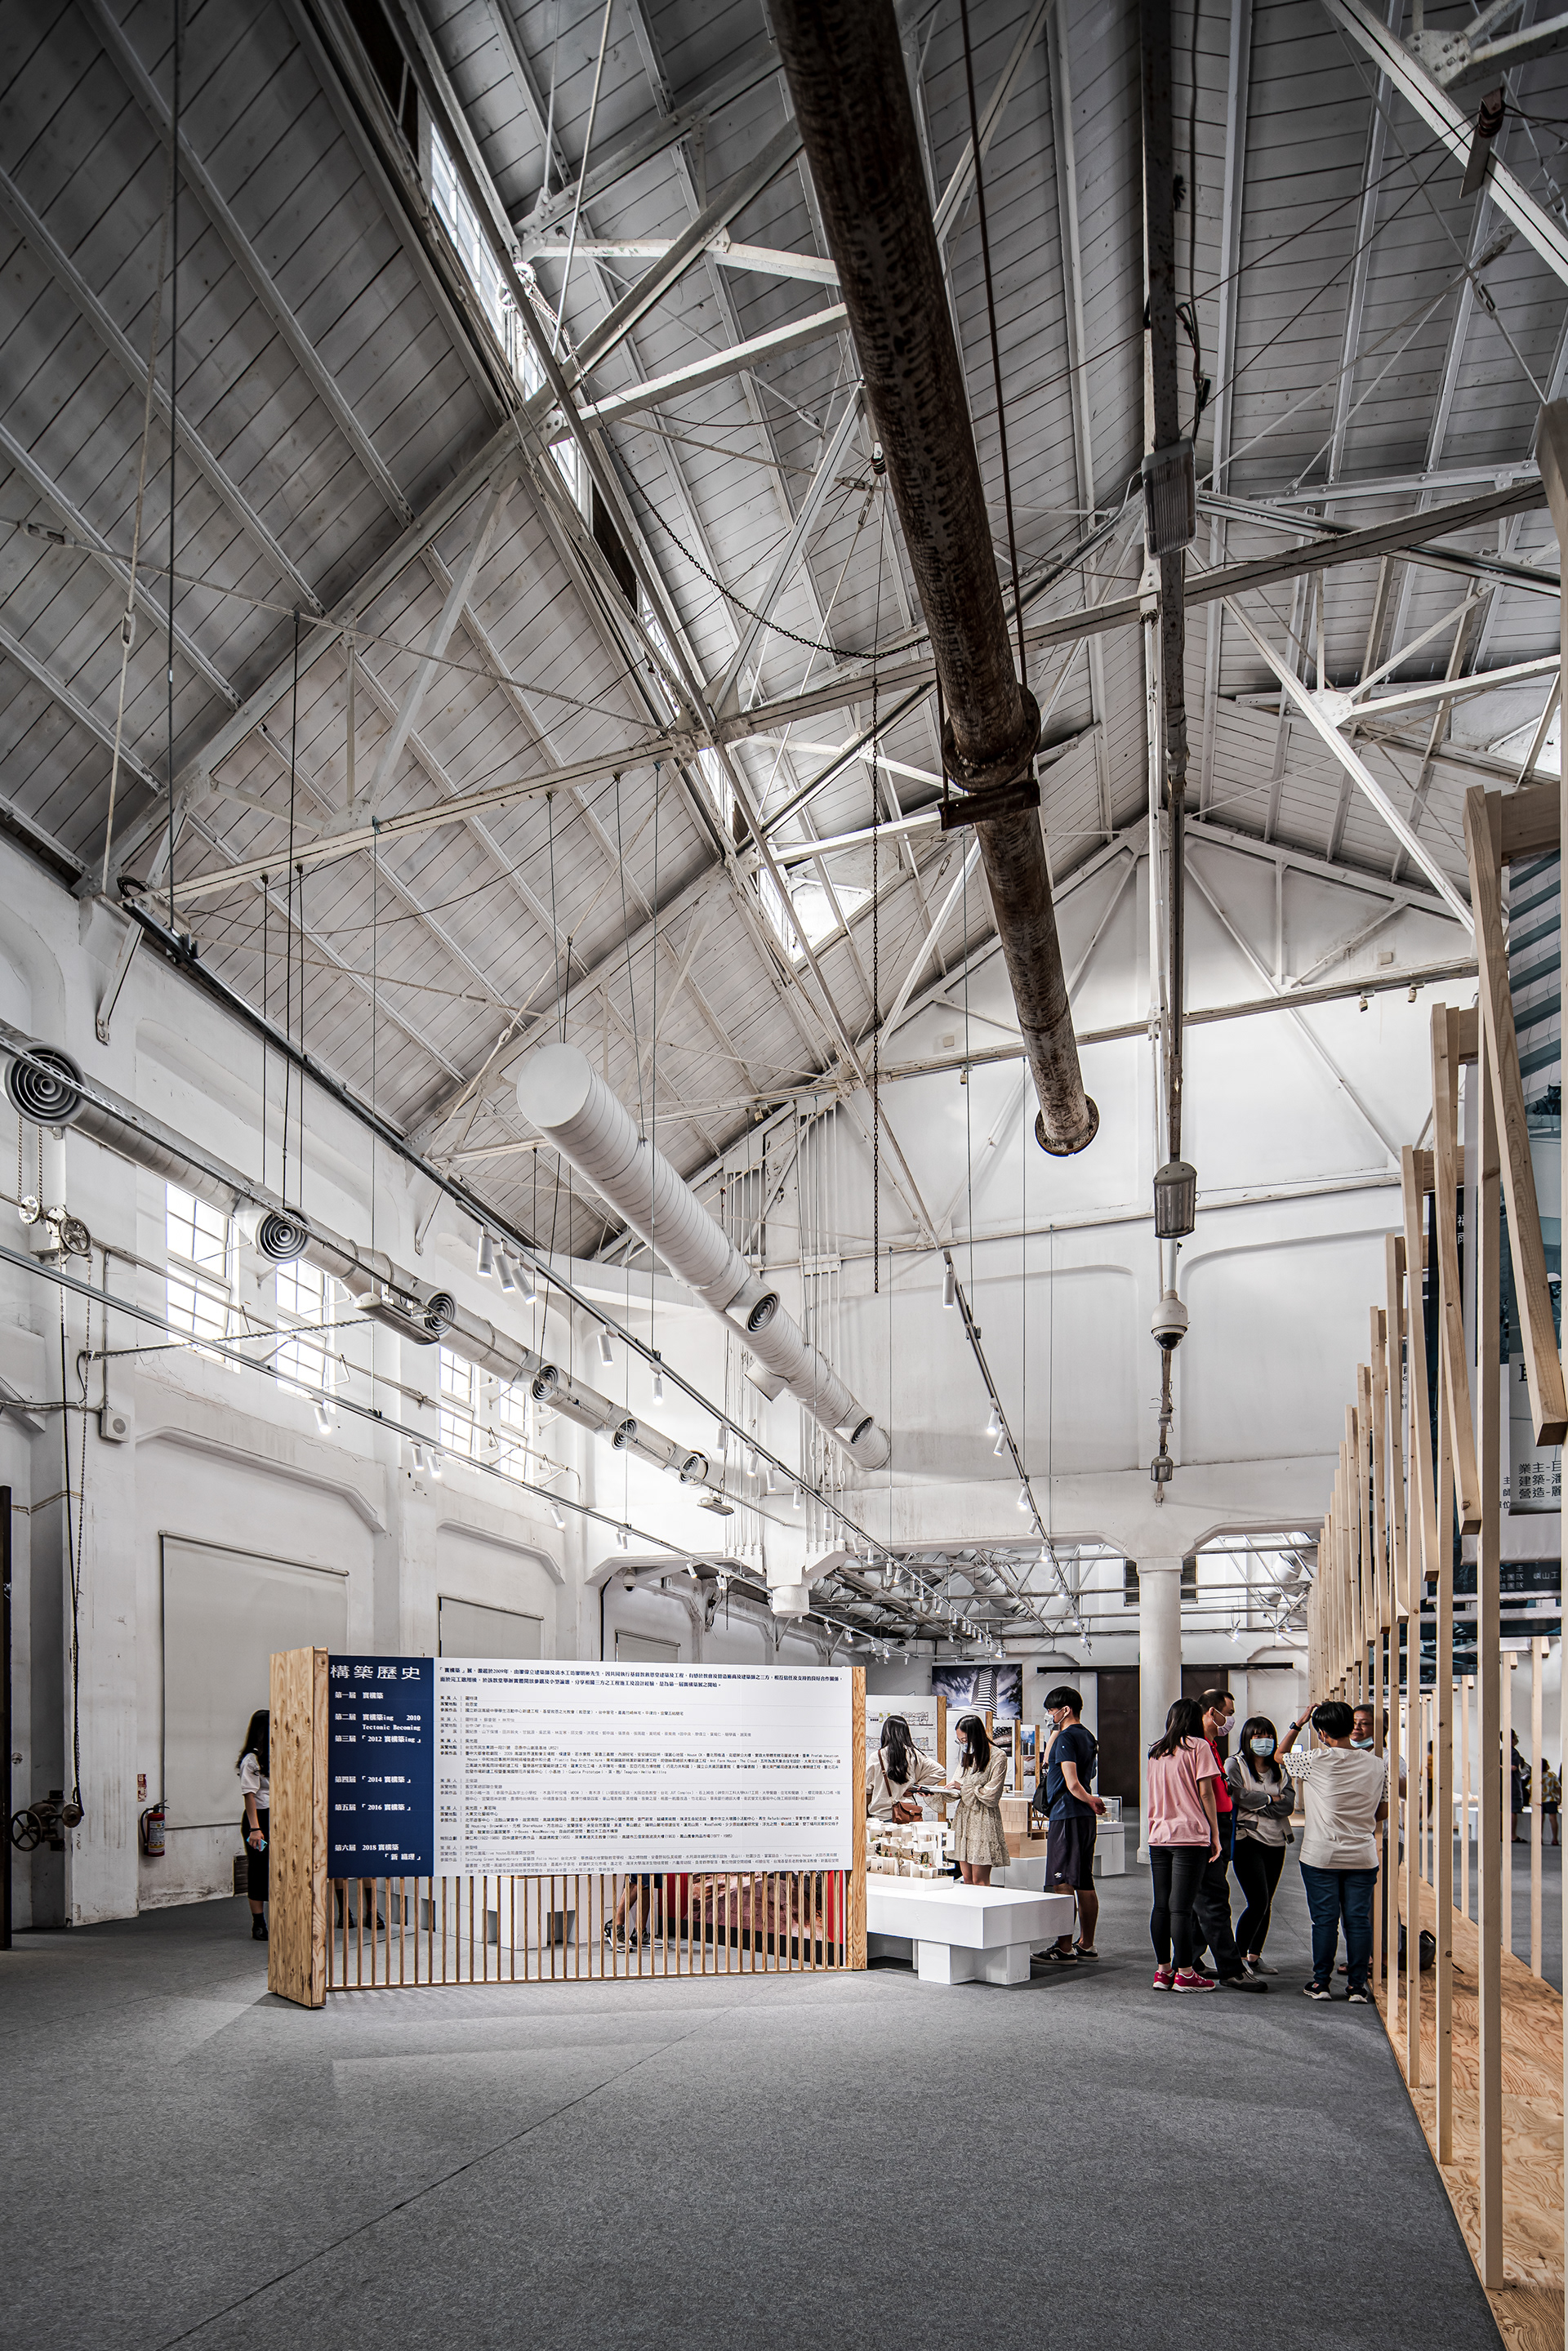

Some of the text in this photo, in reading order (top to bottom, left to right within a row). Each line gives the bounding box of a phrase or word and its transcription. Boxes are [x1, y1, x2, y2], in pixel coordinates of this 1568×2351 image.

[330, 1664, 421, 1681] 構築歷史
[393, 1724, 421, 1732] Becoming
